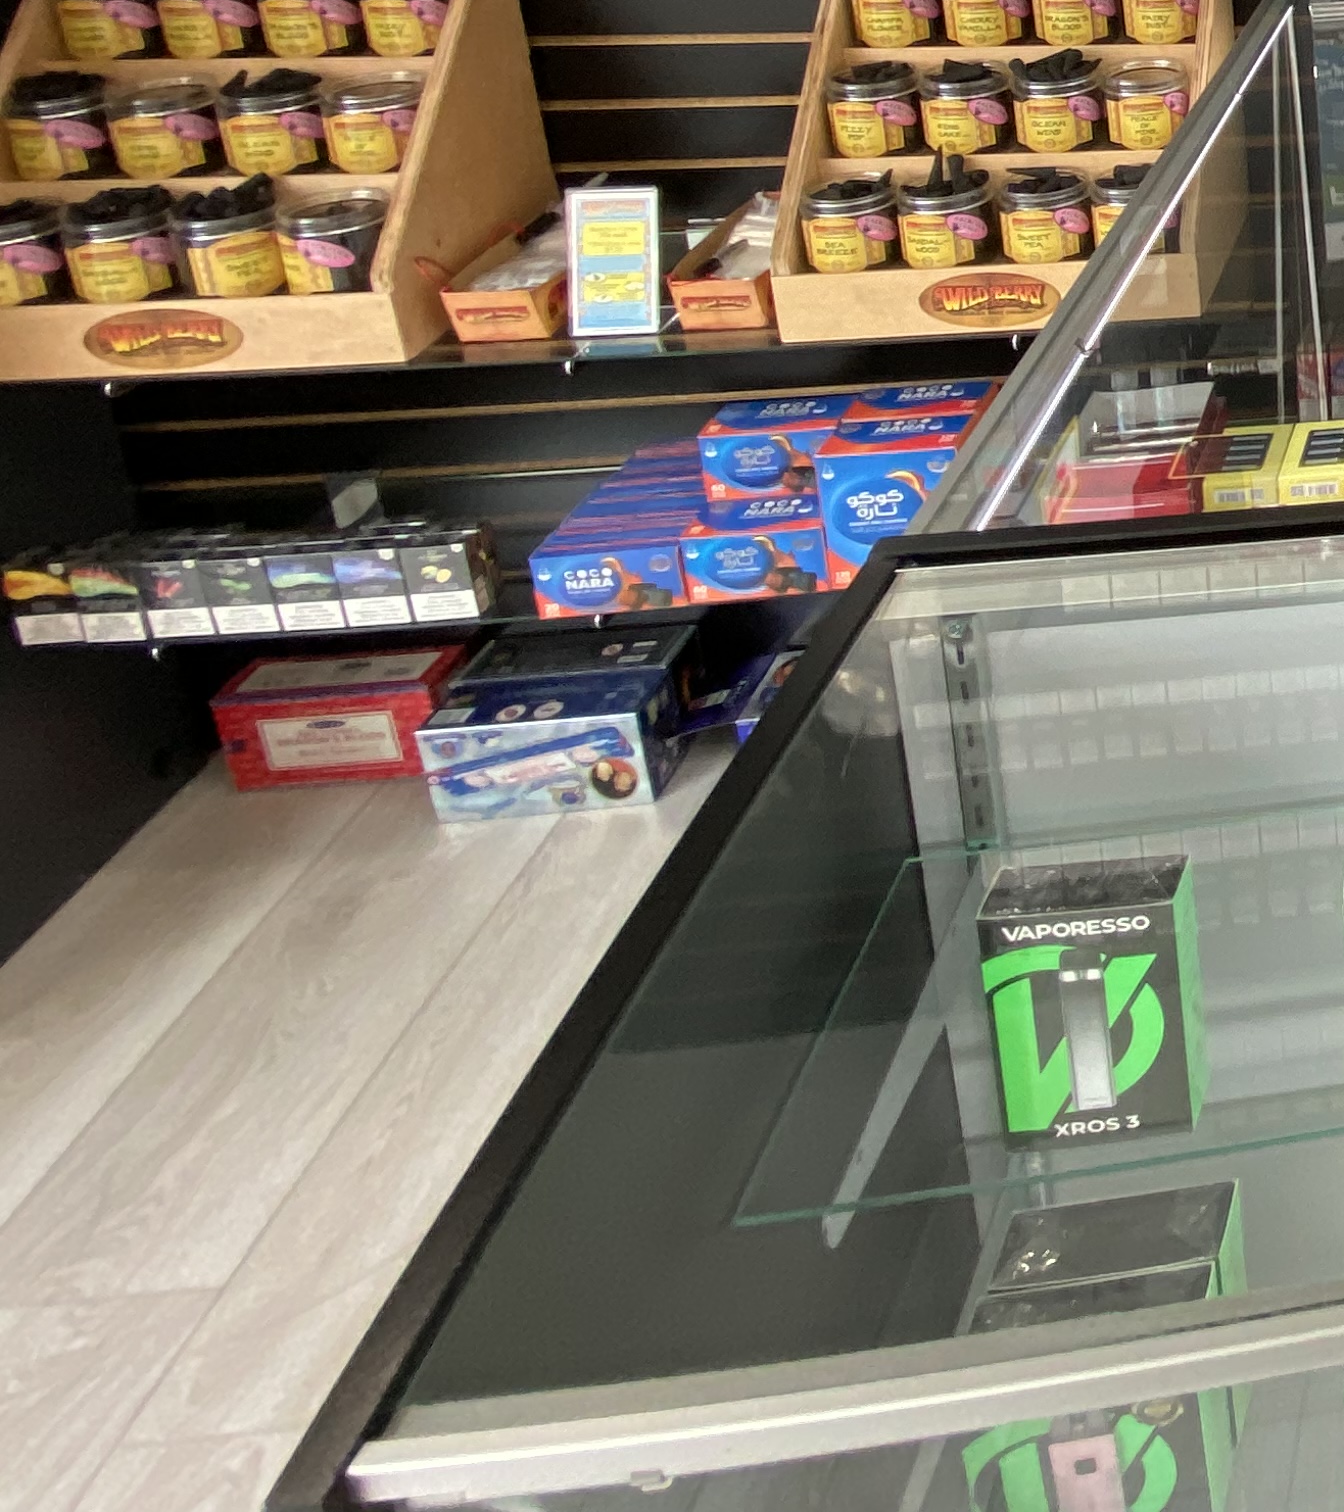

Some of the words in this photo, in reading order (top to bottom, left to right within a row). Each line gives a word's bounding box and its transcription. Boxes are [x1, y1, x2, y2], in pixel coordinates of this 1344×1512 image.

[564, 568, 612, 581] COCO
[564, 579, 614, 591] NARA
[1002, 916, 1151, 943] VAPORESSO
[1054, 1118, 1120, 1139] XROS
[1125, 1115, 1141, 1129] 3
